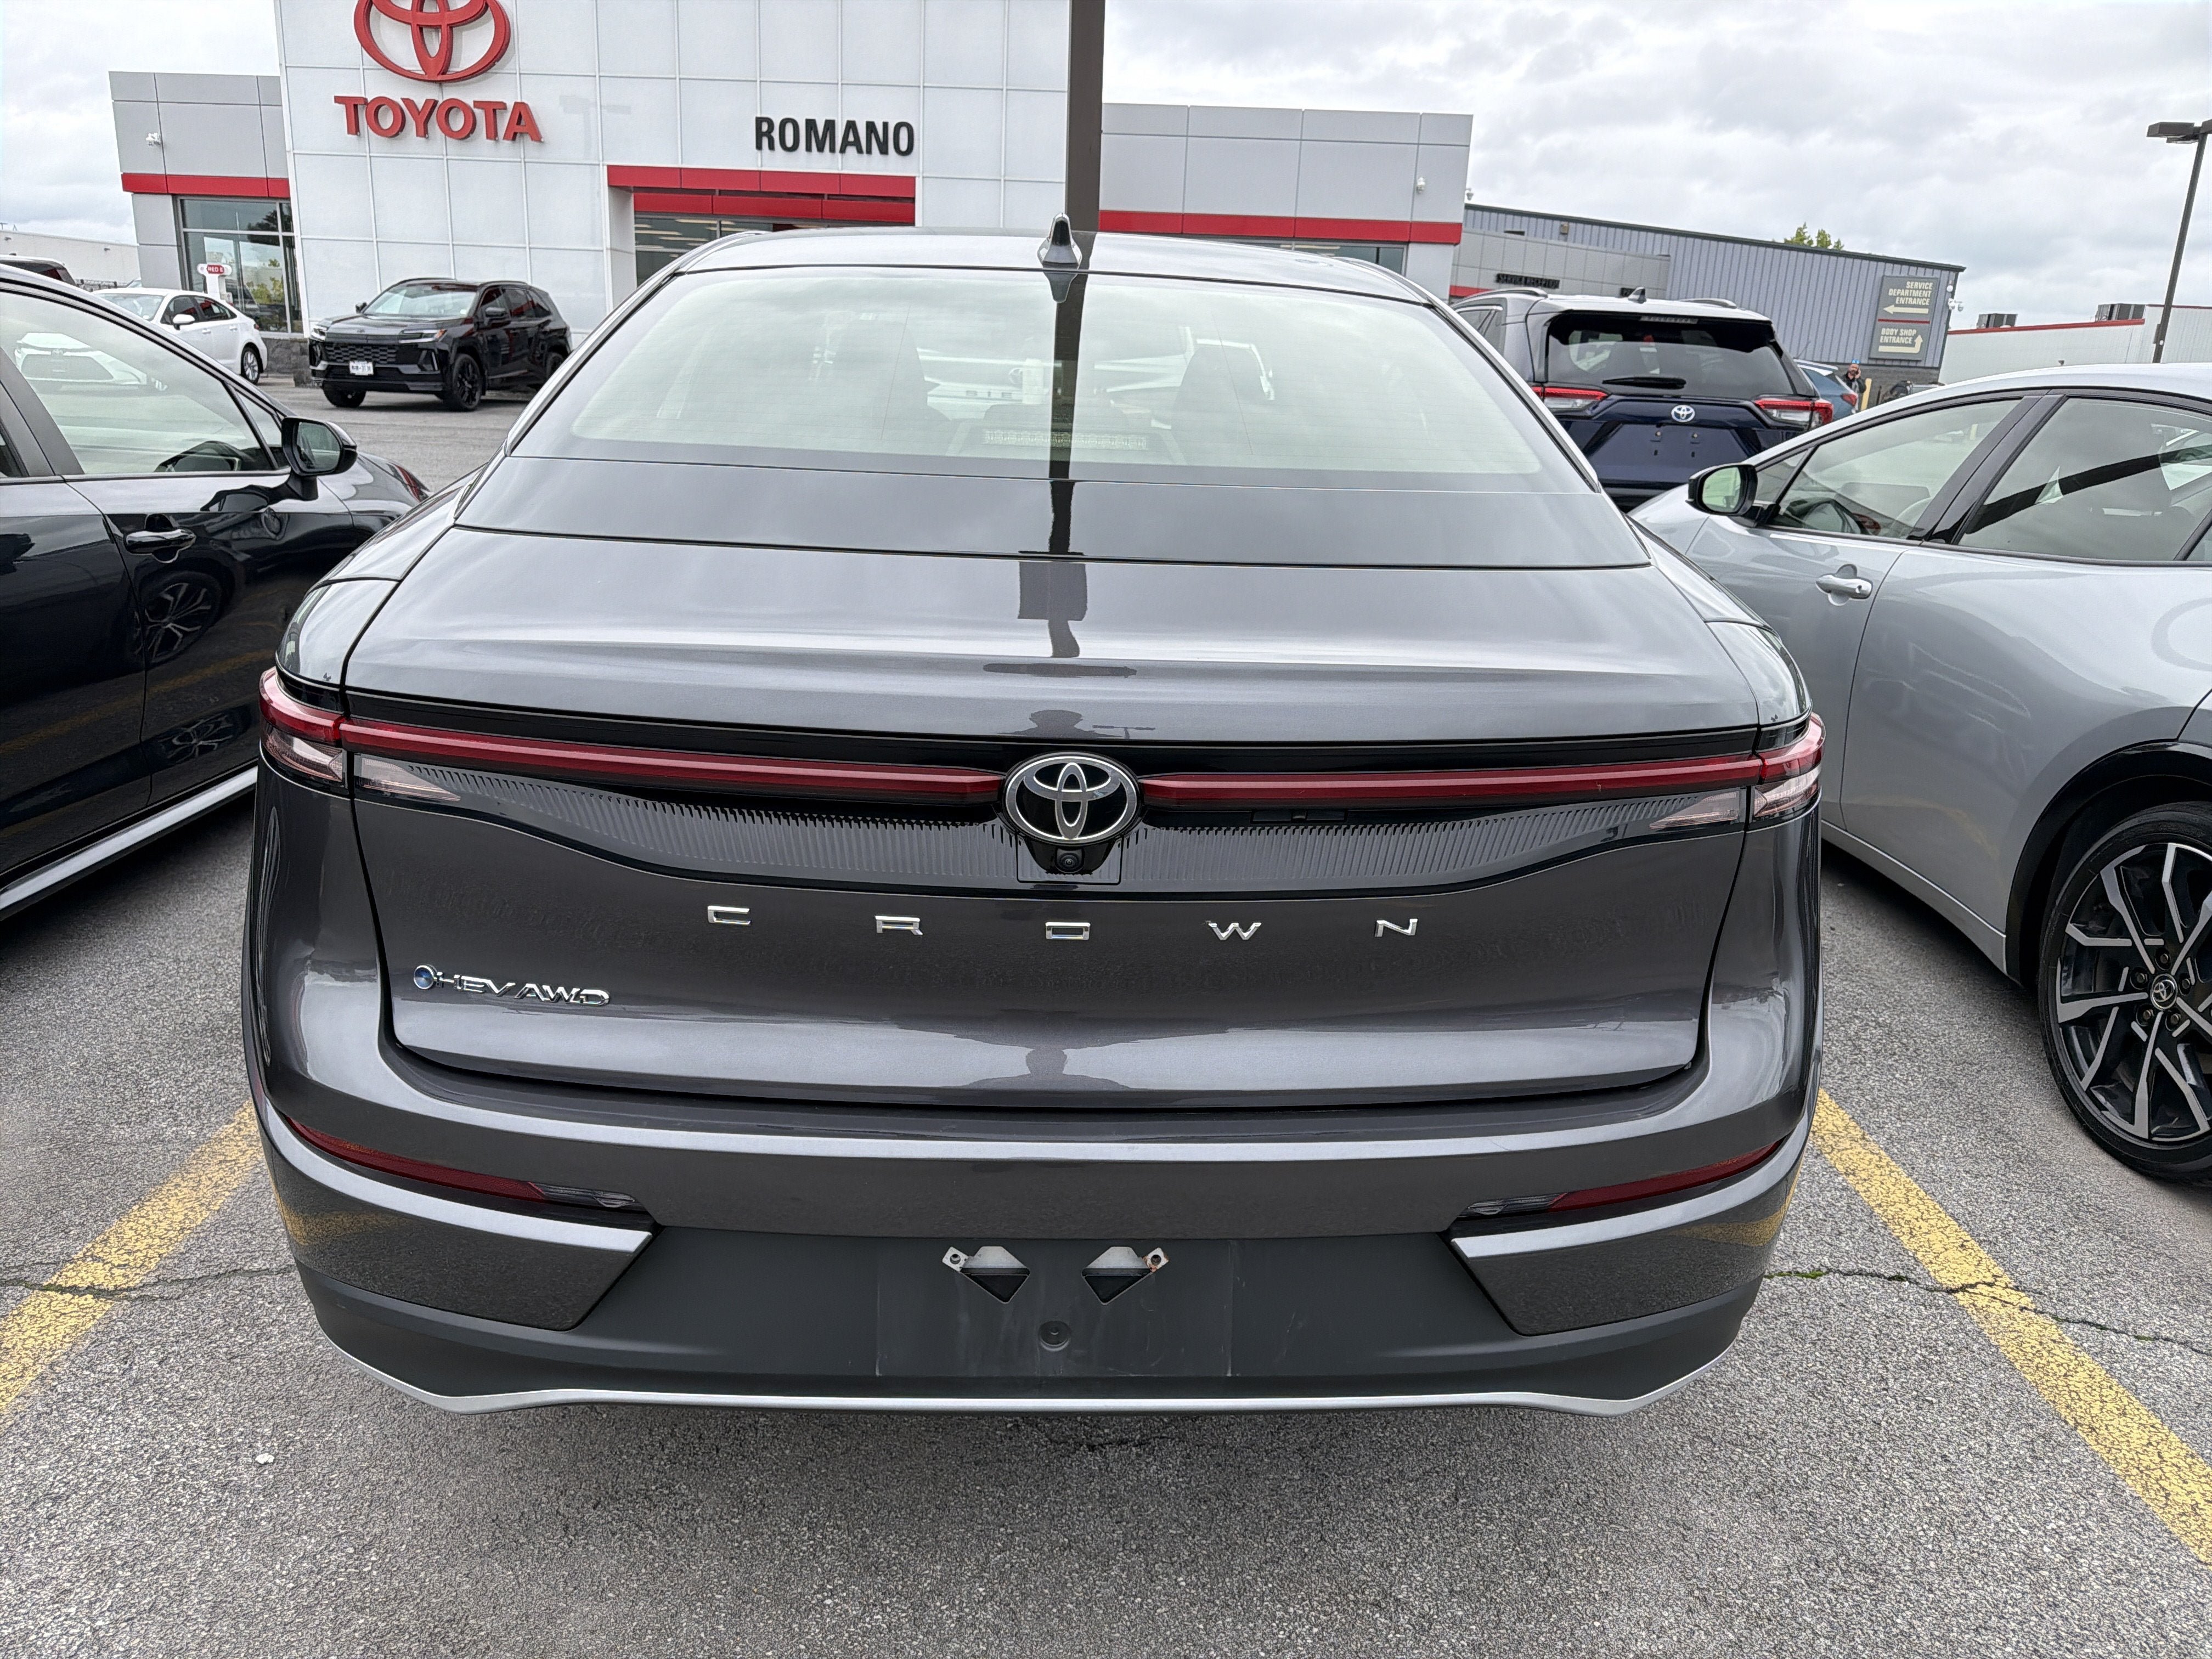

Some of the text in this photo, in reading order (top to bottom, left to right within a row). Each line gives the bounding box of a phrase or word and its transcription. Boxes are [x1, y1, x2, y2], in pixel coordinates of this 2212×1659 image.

[334, 95, 544, 143] TOYOTA
[755, 116, 915, 157] ROMANO
[1888, 288, 1932, 297] DEPARTMENT
[1906, 281, 1933, 289] SERVICE
[1895, 296, 1930, 305] ENTRANCE
[1880, 335, 1912, 344] ENTRANCE
[707, 905, 1418, 940] CROWN
[436, 972, 610, 1007] HEV AWD
